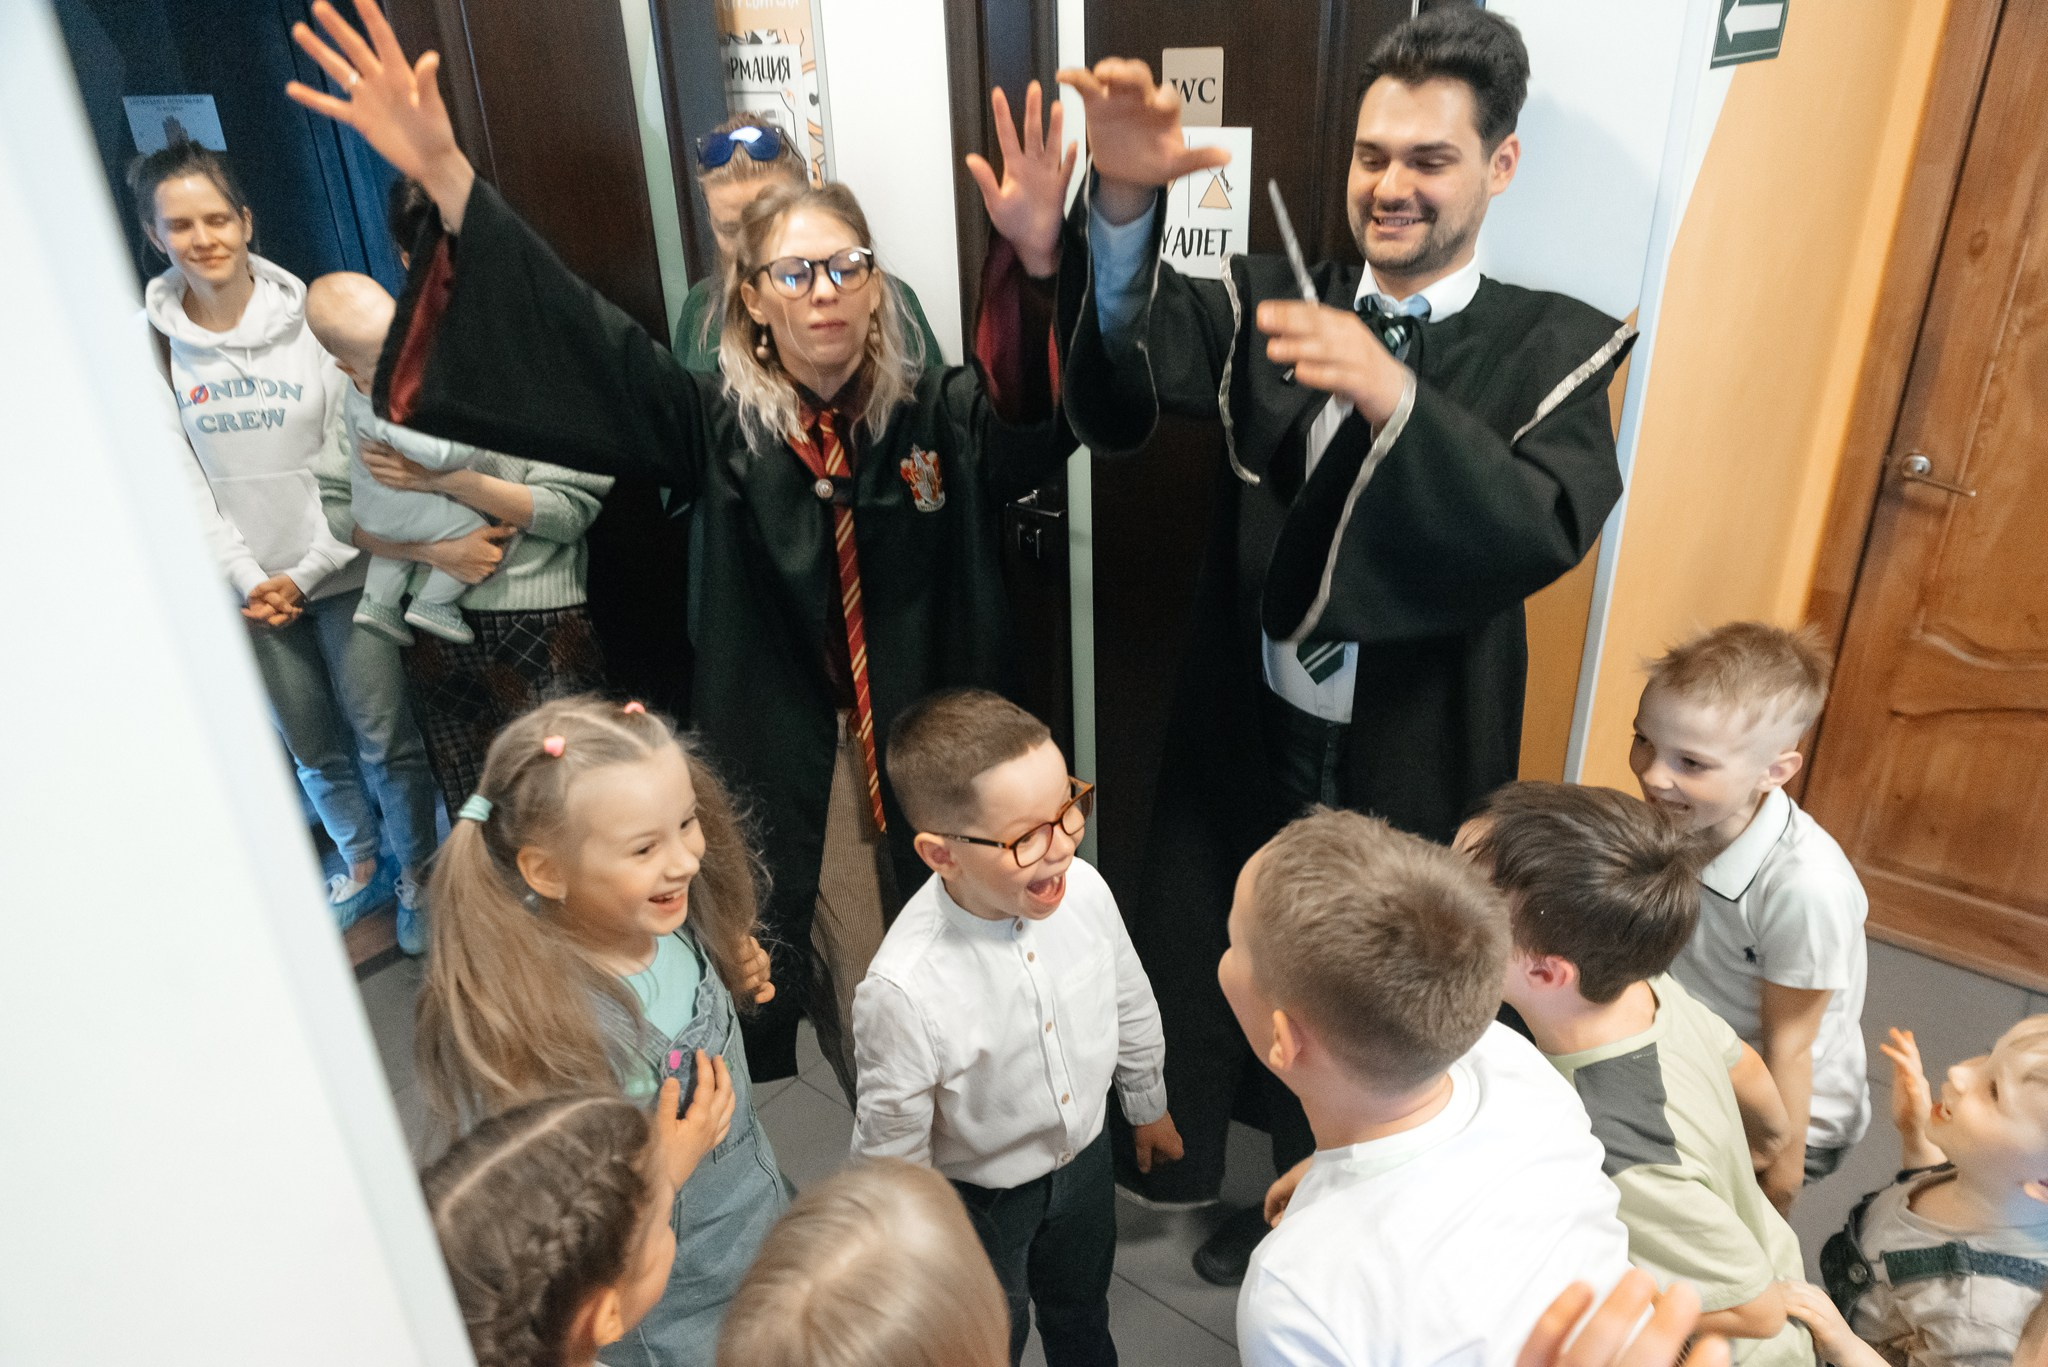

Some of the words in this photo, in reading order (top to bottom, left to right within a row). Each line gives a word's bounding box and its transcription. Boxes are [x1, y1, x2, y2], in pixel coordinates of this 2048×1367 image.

[730, 55, 791, 84] РМАЦИЯ
[1170, 77, 1216, 104] WC
[195, 407, 286, 434] CREW
